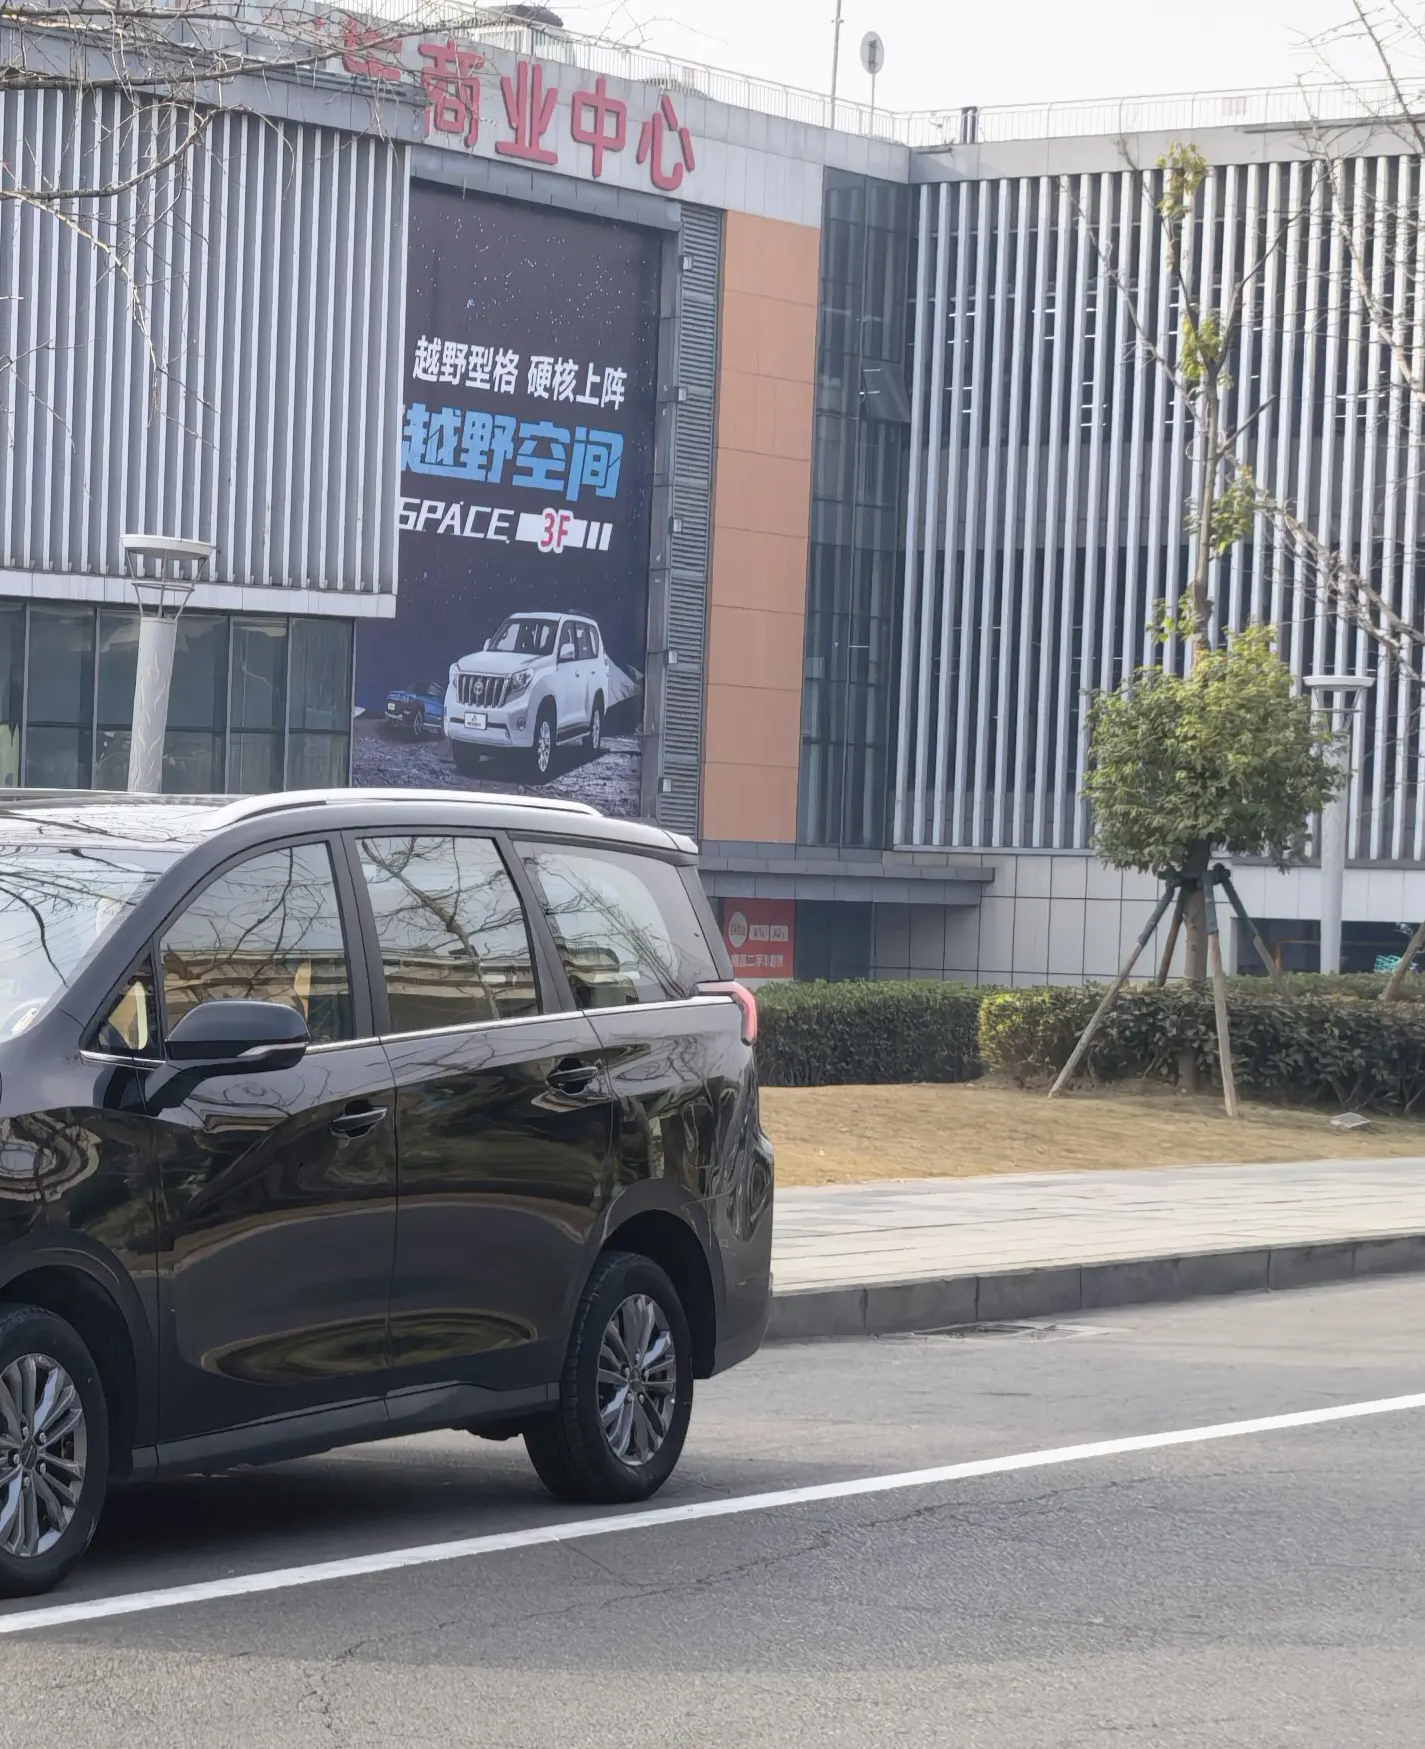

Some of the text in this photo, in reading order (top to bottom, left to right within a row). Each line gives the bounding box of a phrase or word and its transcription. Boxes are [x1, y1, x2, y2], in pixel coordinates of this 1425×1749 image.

[413, 335, 627, 411] 越野型格 硬核上阵
[401, 402, 624, 501] 越野空间
[399, 496, 571, 548] SPACE 3F
